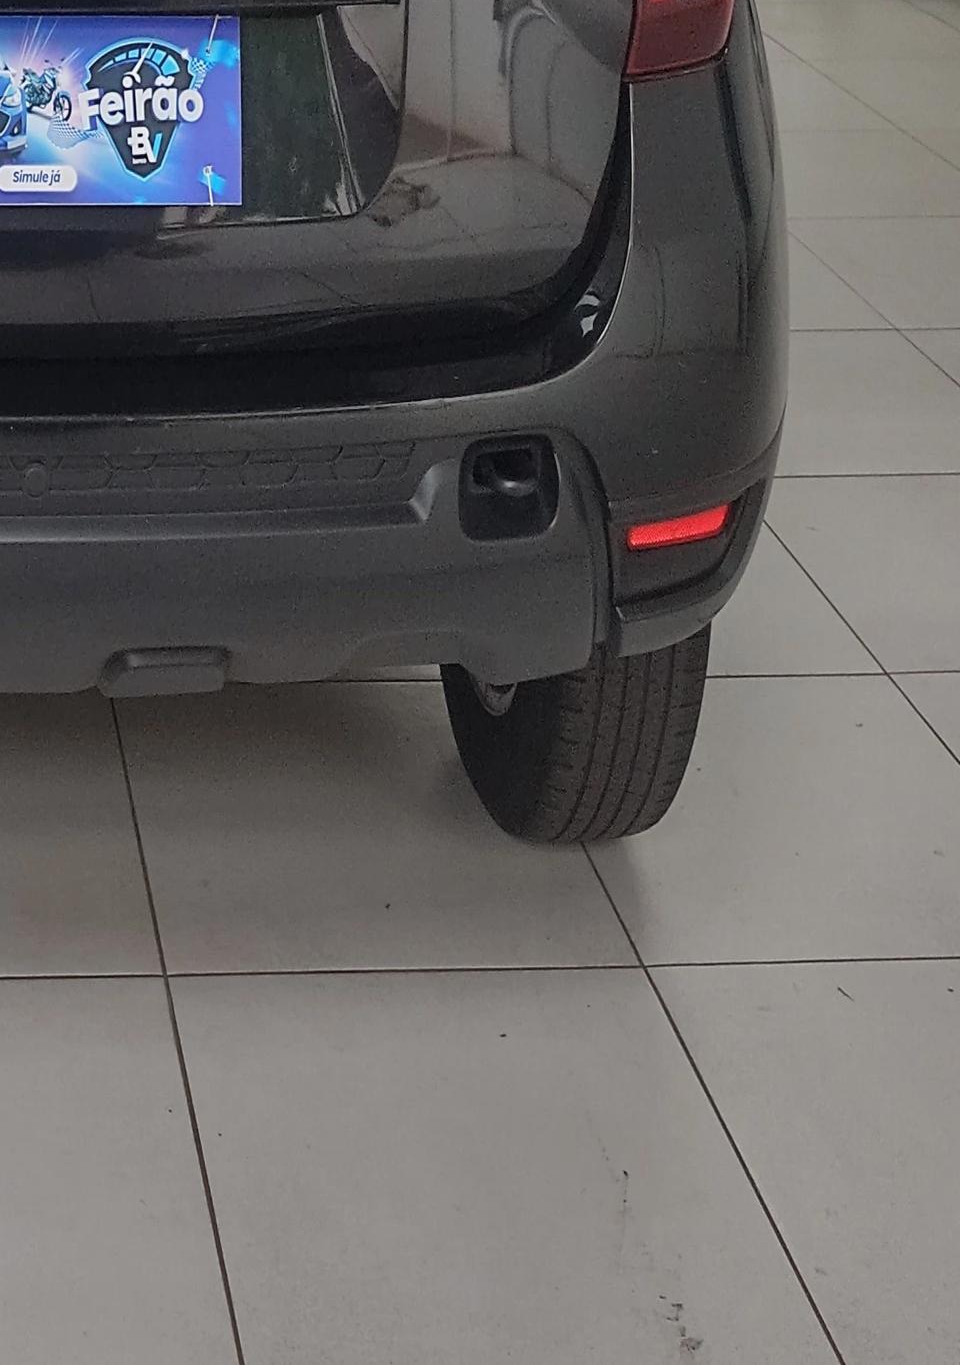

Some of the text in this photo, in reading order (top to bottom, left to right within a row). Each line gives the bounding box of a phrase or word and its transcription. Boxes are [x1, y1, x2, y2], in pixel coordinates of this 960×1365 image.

[78, 75, 205, 132] Feirão
[12, 169, 62, 186] Simule já
